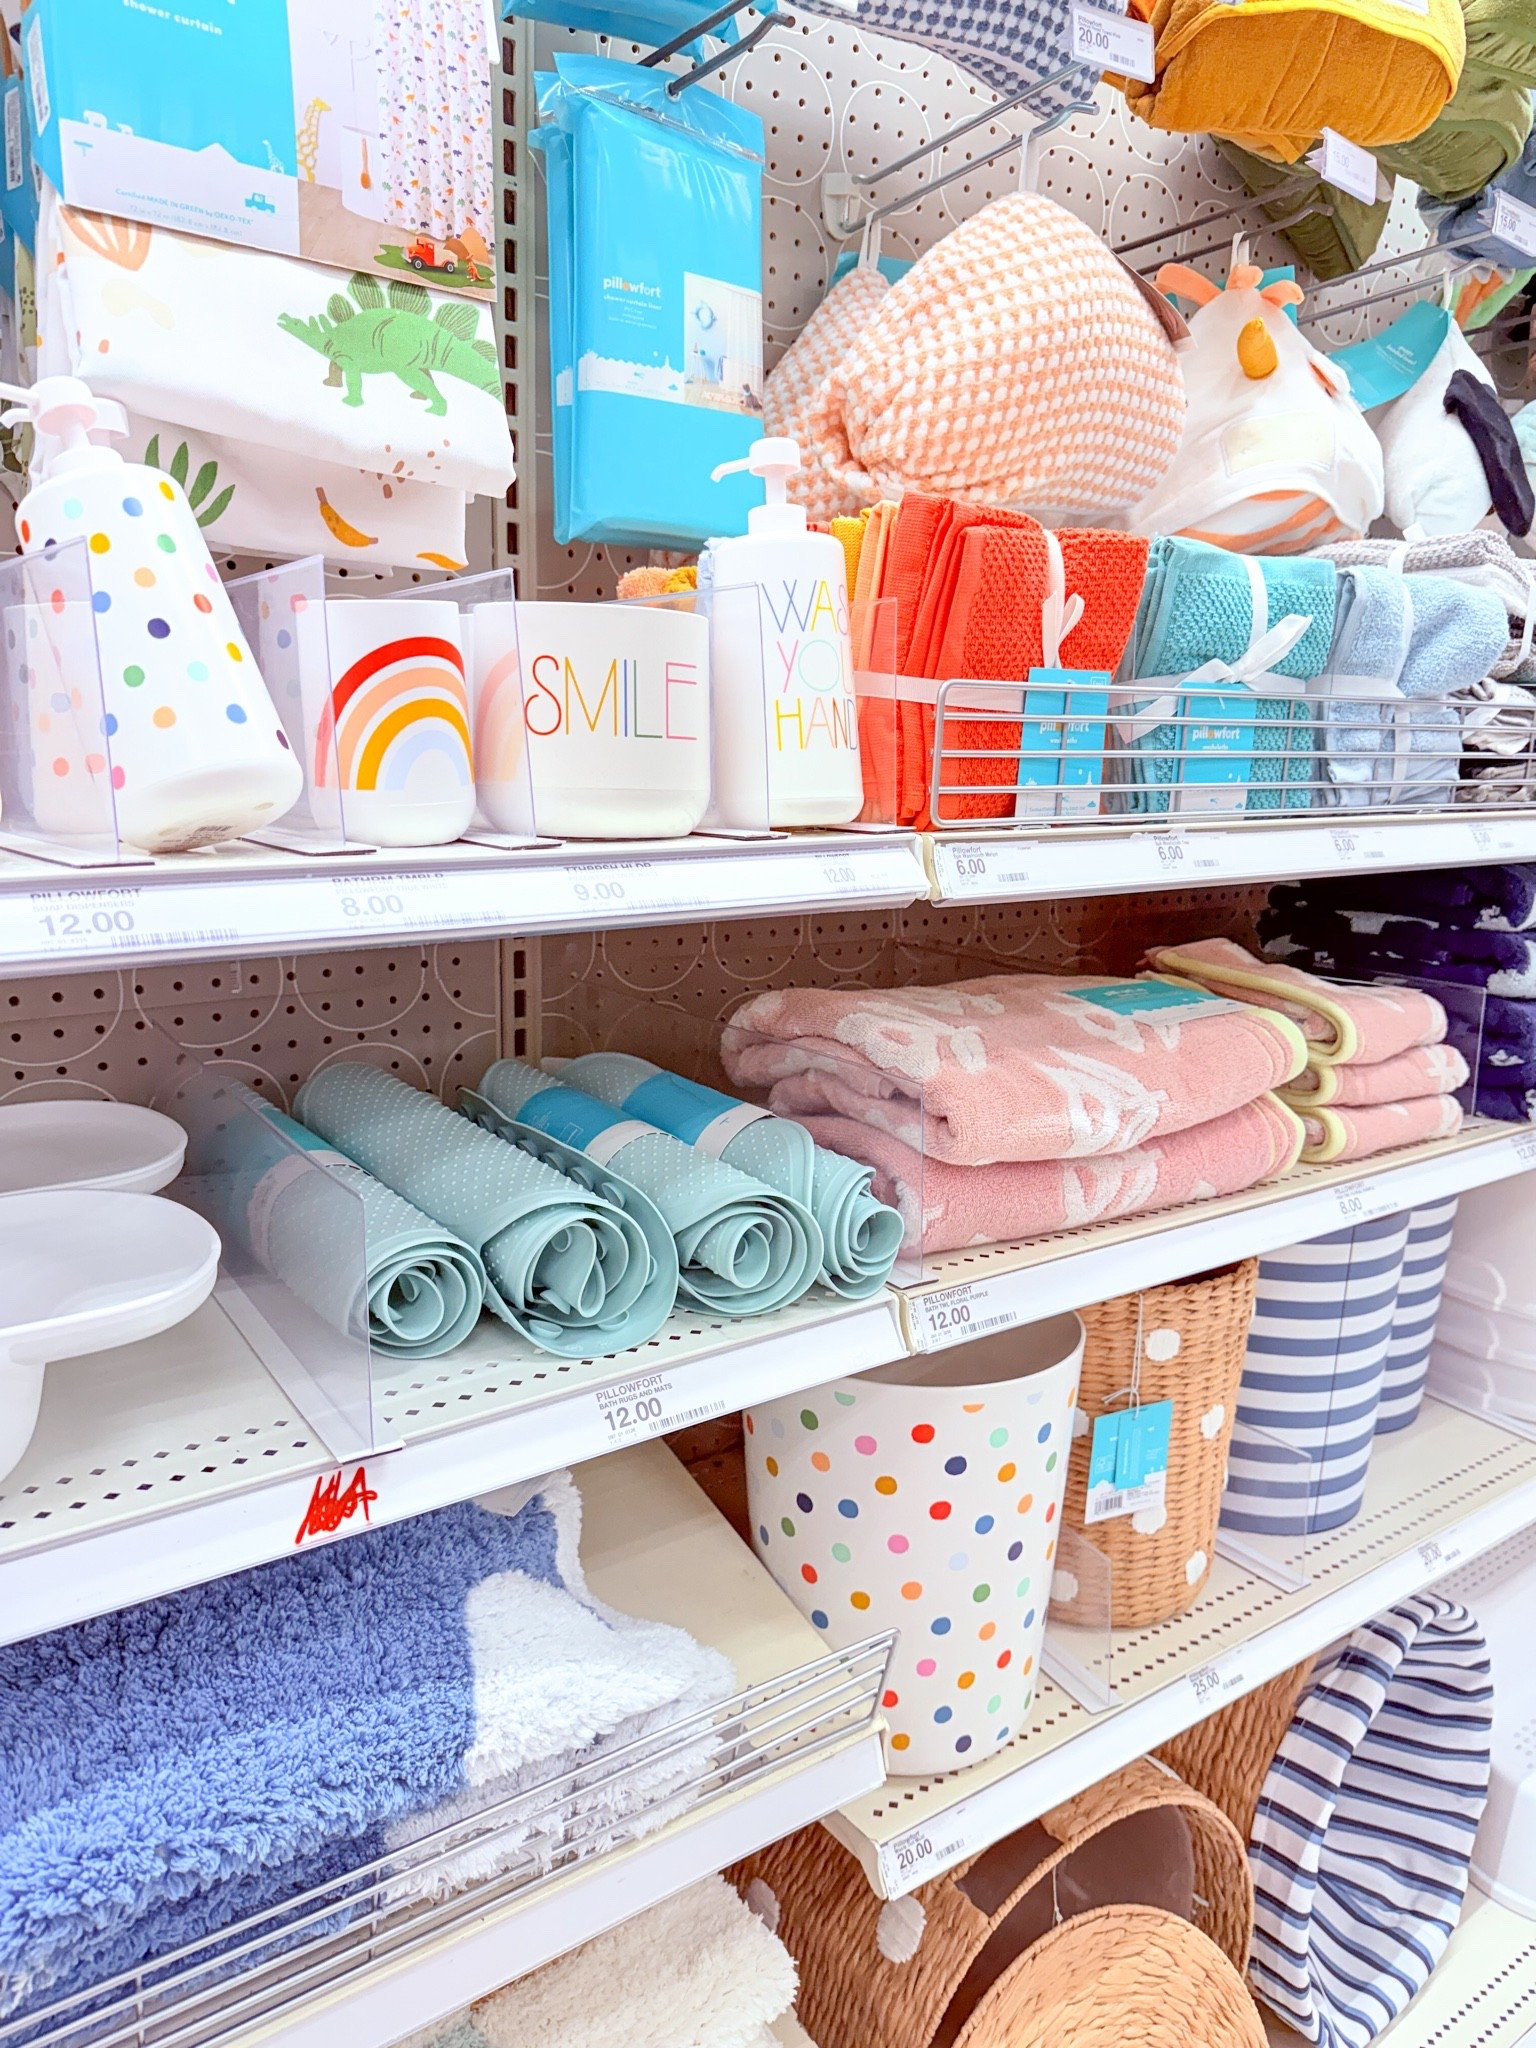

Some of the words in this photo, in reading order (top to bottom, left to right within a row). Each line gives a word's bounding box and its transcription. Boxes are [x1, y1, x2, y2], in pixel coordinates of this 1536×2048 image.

[174, 14, 222, 35] curtain
[1079, 26, 1109, 50] 20.00
[146, 195, 169, 207] MADE
[170, 200, 178, 208] IN
[179, 202, 204, 215] GREEN
[603, 275, 661, 298] pillowfort
[524, 655, 698, 740] SMILE
[1192, 725, 1241, 742] pillowfort
[1158, 845, 1183, 860] 6.00
[1334, 839, 1355, 851] 6.00
[823, 867, 856, 883] 12.00
[956, 858, 986, 875] 6.00
[573, 881, 626, 901] 9.00
[340, 894, 404, 917] 8.00
[38, 910, 135, 937] 12.00
[1339, 1196, 1362, 1215] 8.00
[923, 1285, 973, 1306] PILLOWFORT
[925, 1304, 939, 1313] BATH
[939, 1302, 950, 1310] TWL
[950, 1297, 969, 1306] FLORAL
[970, 1291, 989, 1300] PURPLE
[928, 1304, 971, 1331] 12.00
[595, 1374, 664, 1402] PILLOWFORT
[599, 1400, 618, 1410] BATH
[619, 1395, 638, 1405] RUGS
[639, 1389, 653, 1399] AND
[654, 1382, 673, 1393] MATS
[604, 1397, 662, 1431] 12.00
[1193, 1671, 1219, 1695] 25.00
[897, 1838, 933, 1869] 20.00
